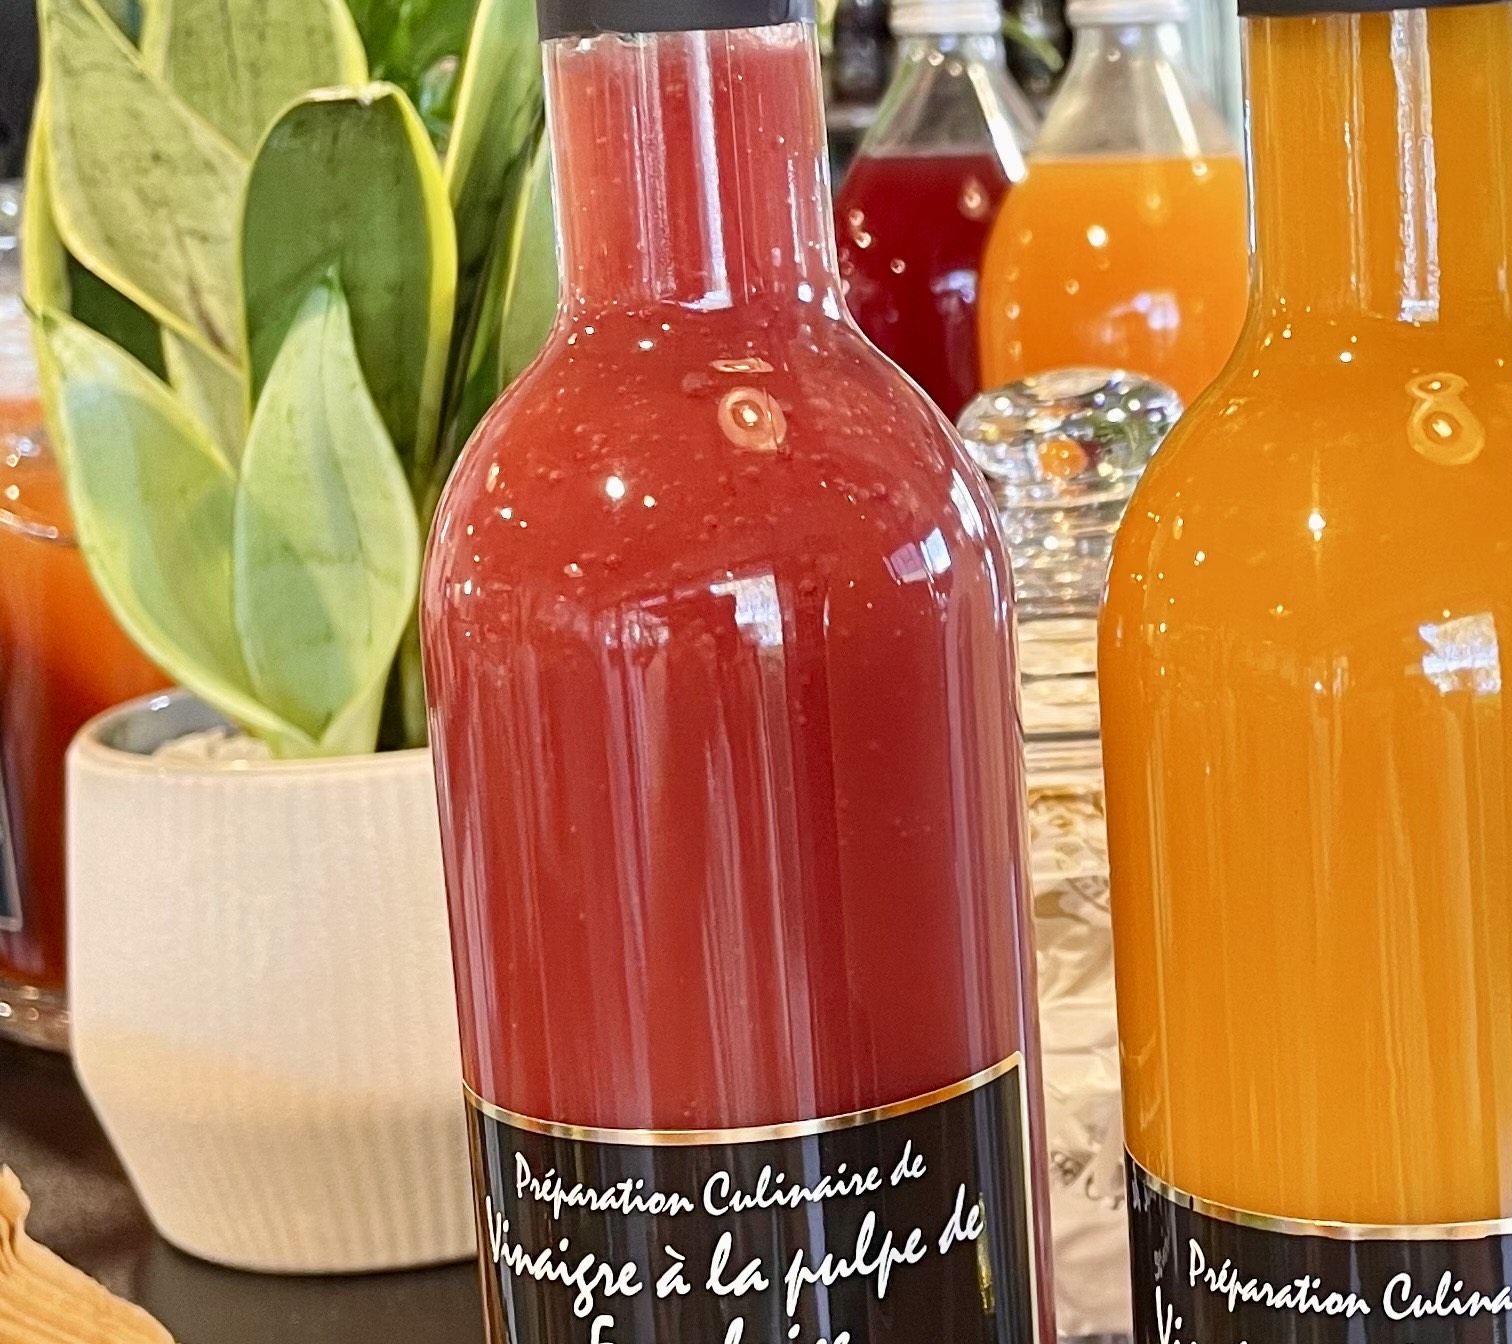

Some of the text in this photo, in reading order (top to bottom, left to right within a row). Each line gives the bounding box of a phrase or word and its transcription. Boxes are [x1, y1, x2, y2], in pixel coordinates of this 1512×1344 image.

[514, 1139, 927, 1218] Préparation Culinaire de
[486, 1184, 984, 1318] Vinaigre à la pulpe de
[1188, 1238, 1371, 1318] Préparation
